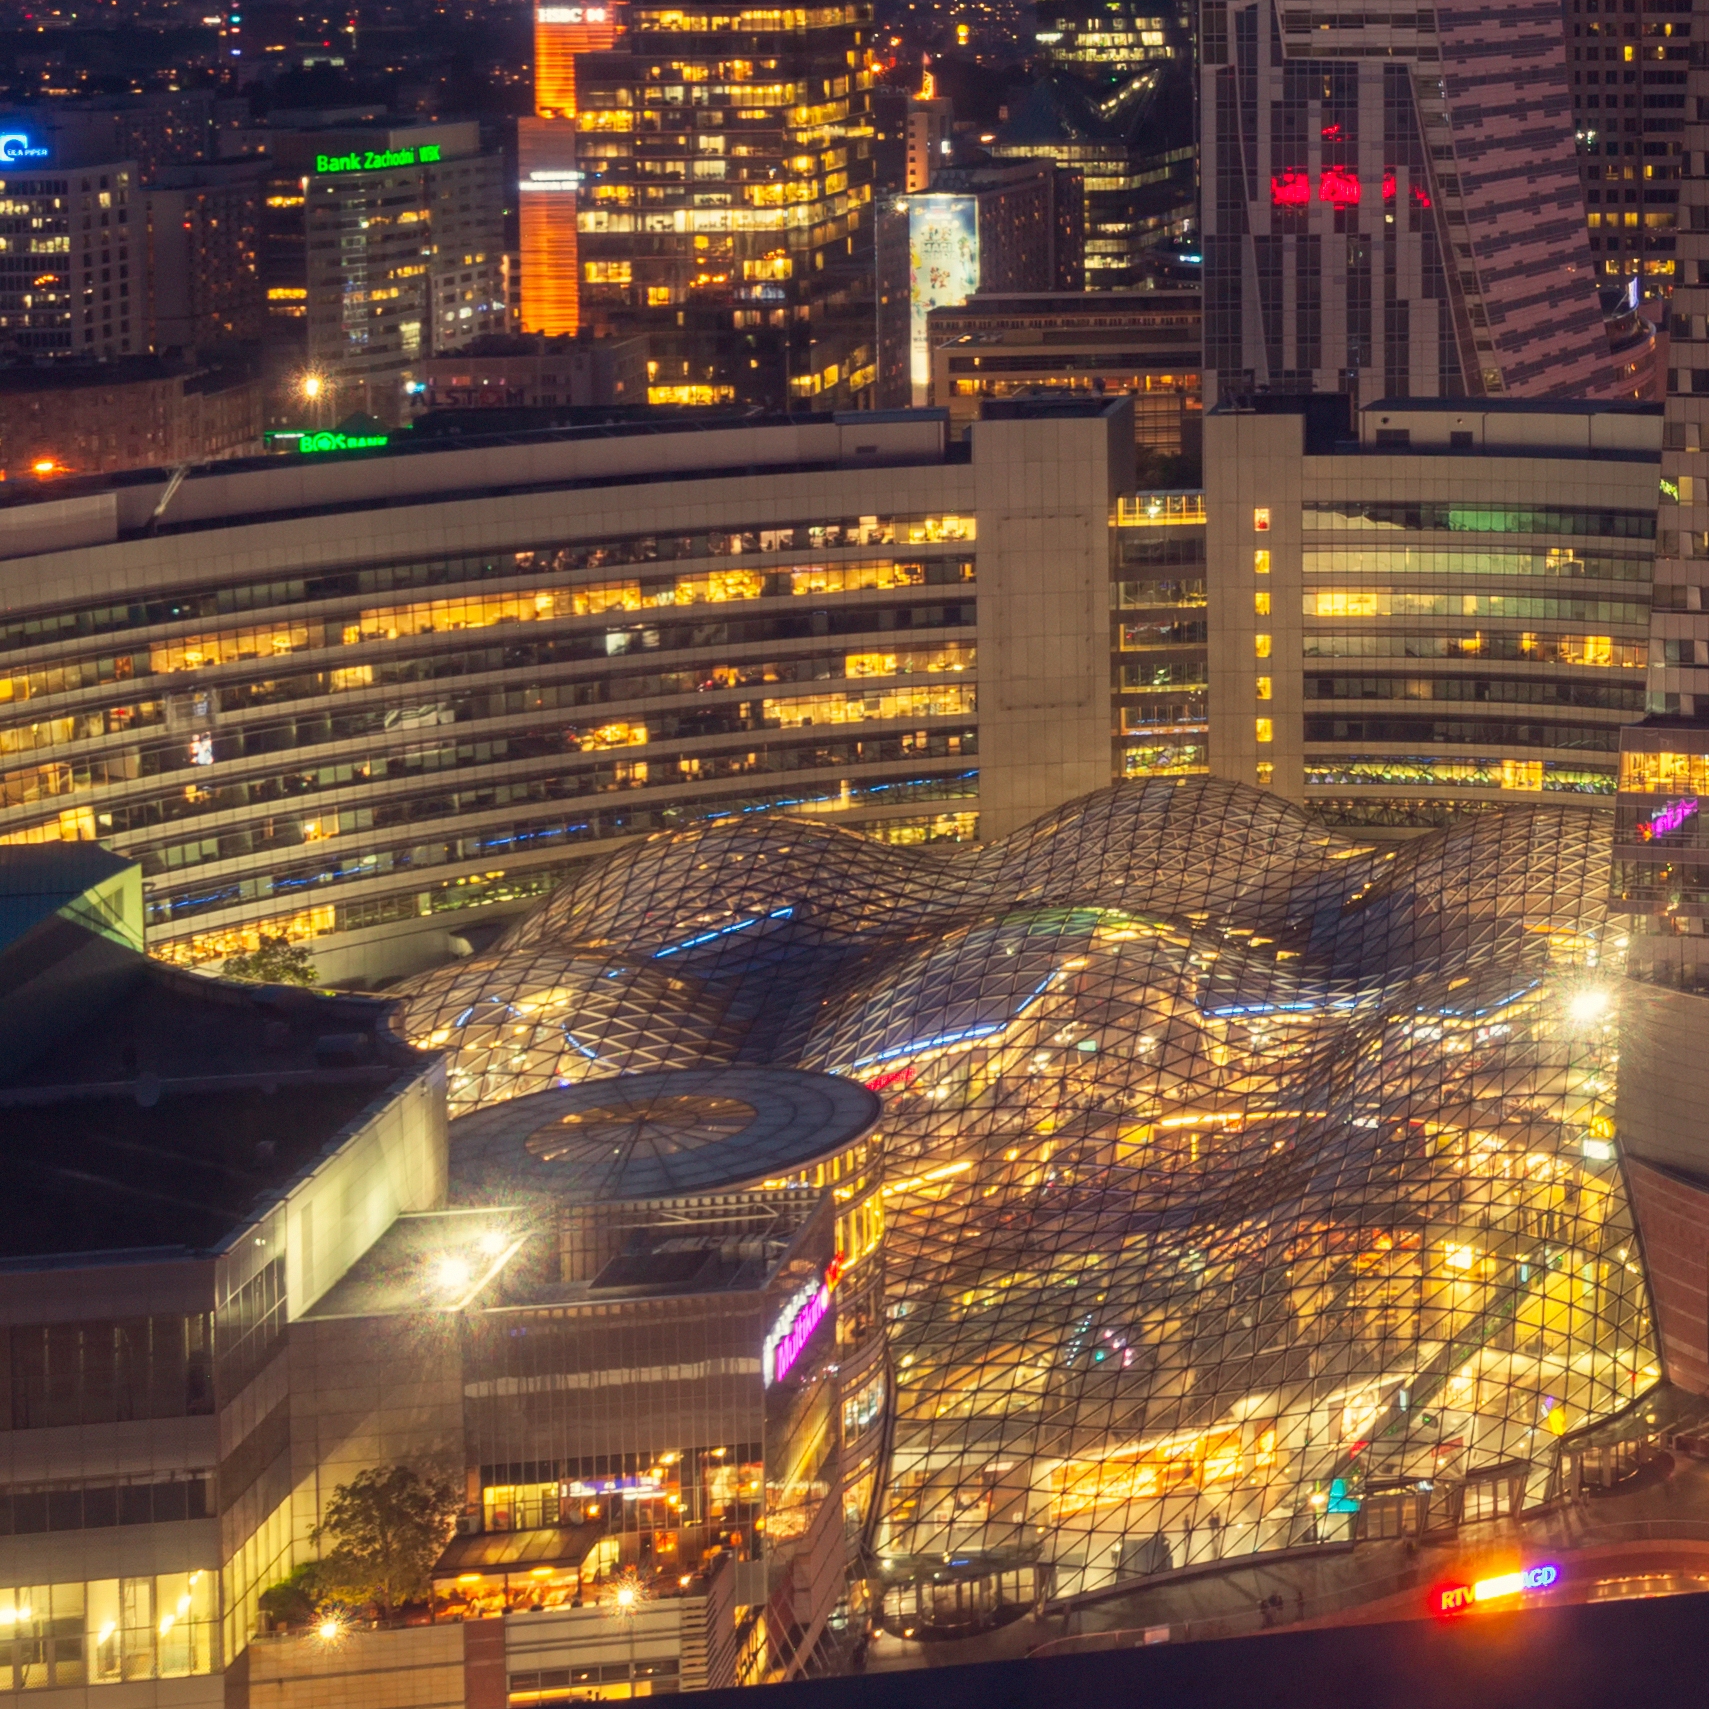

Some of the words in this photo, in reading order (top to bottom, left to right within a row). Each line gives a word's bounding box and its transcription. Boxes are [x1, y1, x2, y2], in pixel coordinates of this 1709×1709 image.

[538, 8, 583, 22] HSBC
[316, 152, 361, 172] Bank
[363, 147, 414, 169] Zachodni
[1441, 1587, 1475, 1610] RTV
